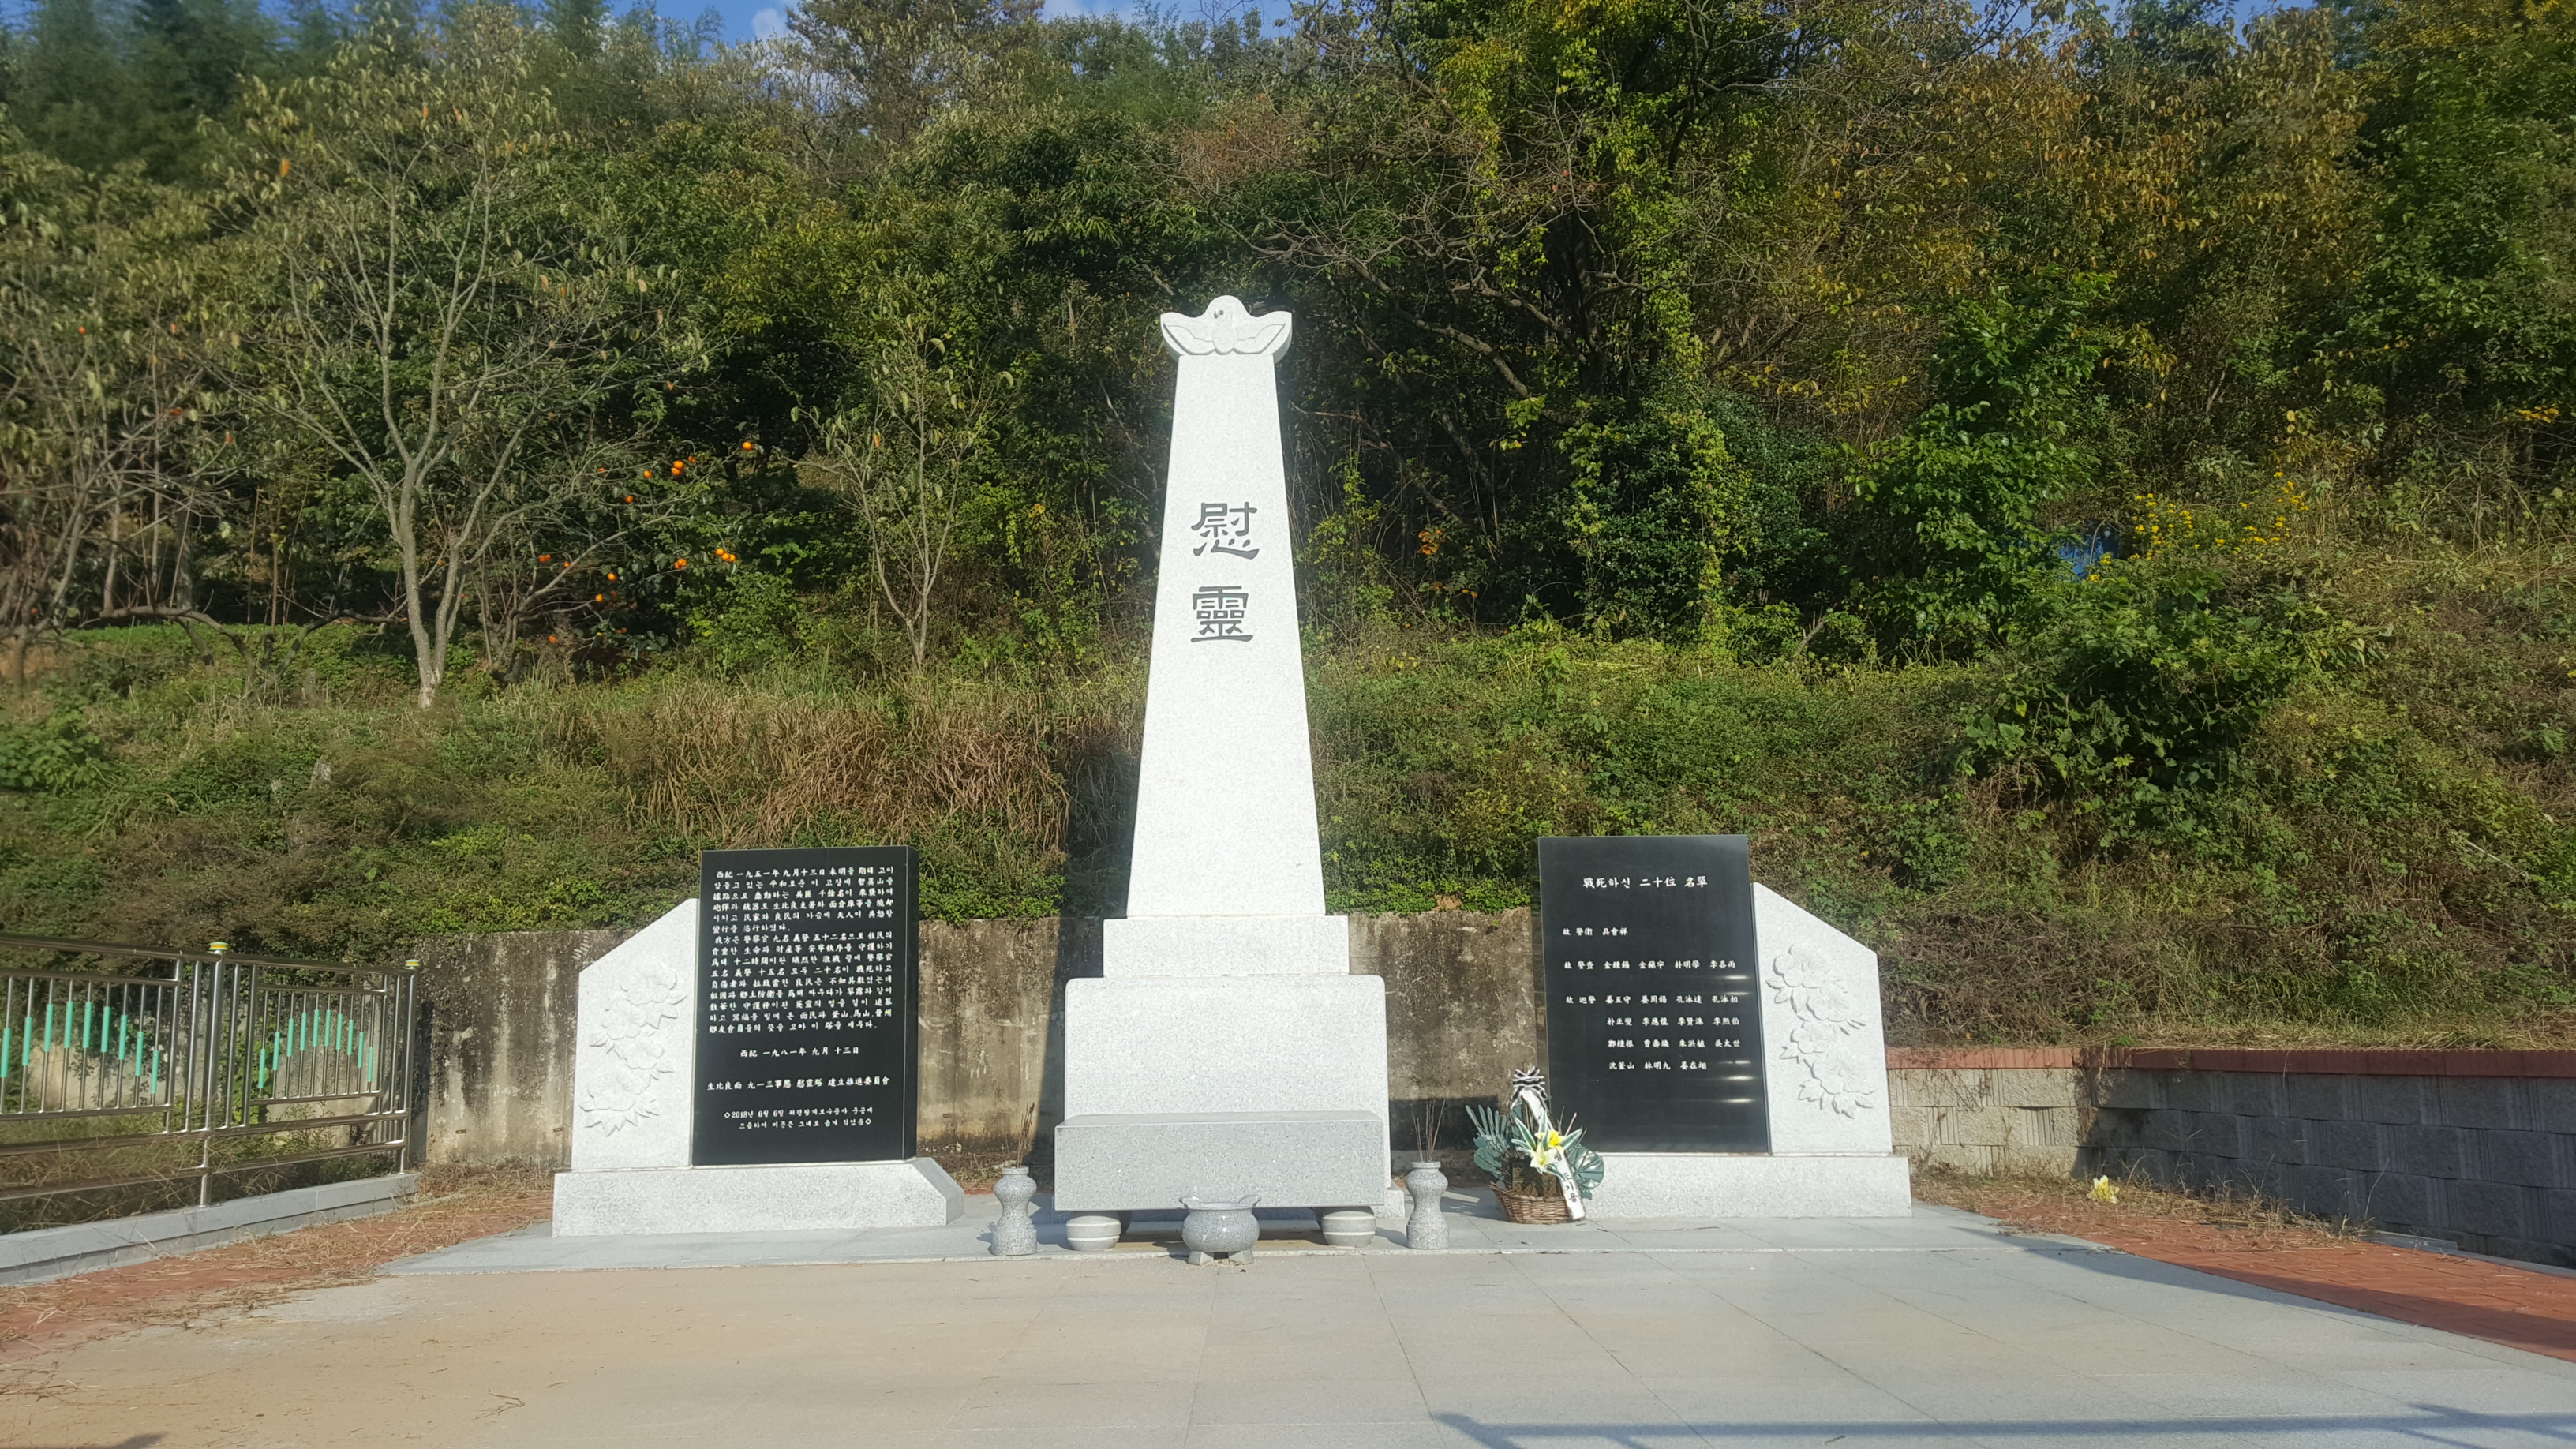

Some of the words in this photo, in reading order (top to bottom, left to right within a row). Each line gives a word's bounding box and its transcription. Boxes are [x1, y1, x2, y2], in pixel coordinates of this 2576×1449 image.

[1191, 502, 1260, 642] 慰靈
[716, 871, 734, 879] 西紀
[736, 868, 780, 878] 一九五一年
[783, 868, 826, 878] 九月十三日
[829, 867, 855, 876] 未明을
[878, 866, 893, 874] 고이
[714, 881, 740, 890] 잠들고
[746, 880, 764, 889] 있는
[811, 878, 818, 887] 이
[825, 878, 851, 887] 고장에
[1583, 877, 1631, 889] 戰死하신
[1639, 876, 1677, 888] 二十位
[1684, 875, 1708, 888] 名單
[795, 889, 812, 899] 共匪
[773, 900, 826, 911] 生比良支署와
[829, 898, 873, 909] 面倉庫等을
[713, 913, 739, 923] 시키고
[743, 912, 770, 923] 民家와
[774, 912, 800, 922] 良民의
[806, 911, 831, 920] 가슴에
[837, 910, 862, 919] 天人이
[714, 935, 740, 945] 我方은
[743, 934, 769, 944] 警察官
[772, 934, 789, 943] 九名
[813, 932, 865, 942] 五十二名으로
[867, 930, 893, 940] 住民의
[712, 946, 738, 957] 貴重한
[743, 945, 770, 955] 生命과
[858, 942, 893, 952] 守護하기
[733, 956, 787, 966] 十二時間이란
[844, 953, 861, 964] 끝에
[867, 953, 893, 962] 警察官
[710, 969, 728, 978] 五名
[758, 967, 785, 977] 十五名
[790, 966, 808, 975] 모두
[814, 964, 849, 975] 二十名이
[856, 964, 893, 974] 戰死하고
[711, 979, 747, 990] 負傷者와
[796, 977, 822, 987] 良民은
[710, 990, 736, 1001] 祖國과
[808, 987, 843, 997] 싸우다가
[876, 986, 892, 996] 같이
[795, 999, 822, 1009] 英靈의
[827, 998, 846, 1009] 얼을
[852, 998, 868, 1008] 길이
[874, 997, 893, 1007] 追慕
[710, 1013, 726, 1022] 하고
[763, 1012, 780, 1021] 빌며
[786, 1011, 795, 1020] 온
[799, 1010, 826, 1020] 面民과
[767, 1022, 784, 1032] 뜻을
[789, 1022, 807, 1031] 모아
[811, 1021, 819, 1030] 이
[824, 1020, 842, 1031] 塔을
[848, 1020, 878, 1029] 세우다.
[740, 1049, 758, 1058] 西紀
[762, 1047, 807, 1058] 一九八一年
[811, 1046, 829, 1056] 九月
[834, 1046, 859, 1055] 十三日
[1644, 1061, 1671, 1070] 林明九
[707, 1080, 743, 1091] 生比良面
[747, 1079, 792, 1090] 九一三事態
[796, 1078, 823, 1088] 慰靈塔
[732, 1110, 754, 1119] 2018년
[758, 1110, 769, 1118] 6월
[773, 1109, 784, 1118] 6일
[772, 1120, 794, 1129] 비문은
